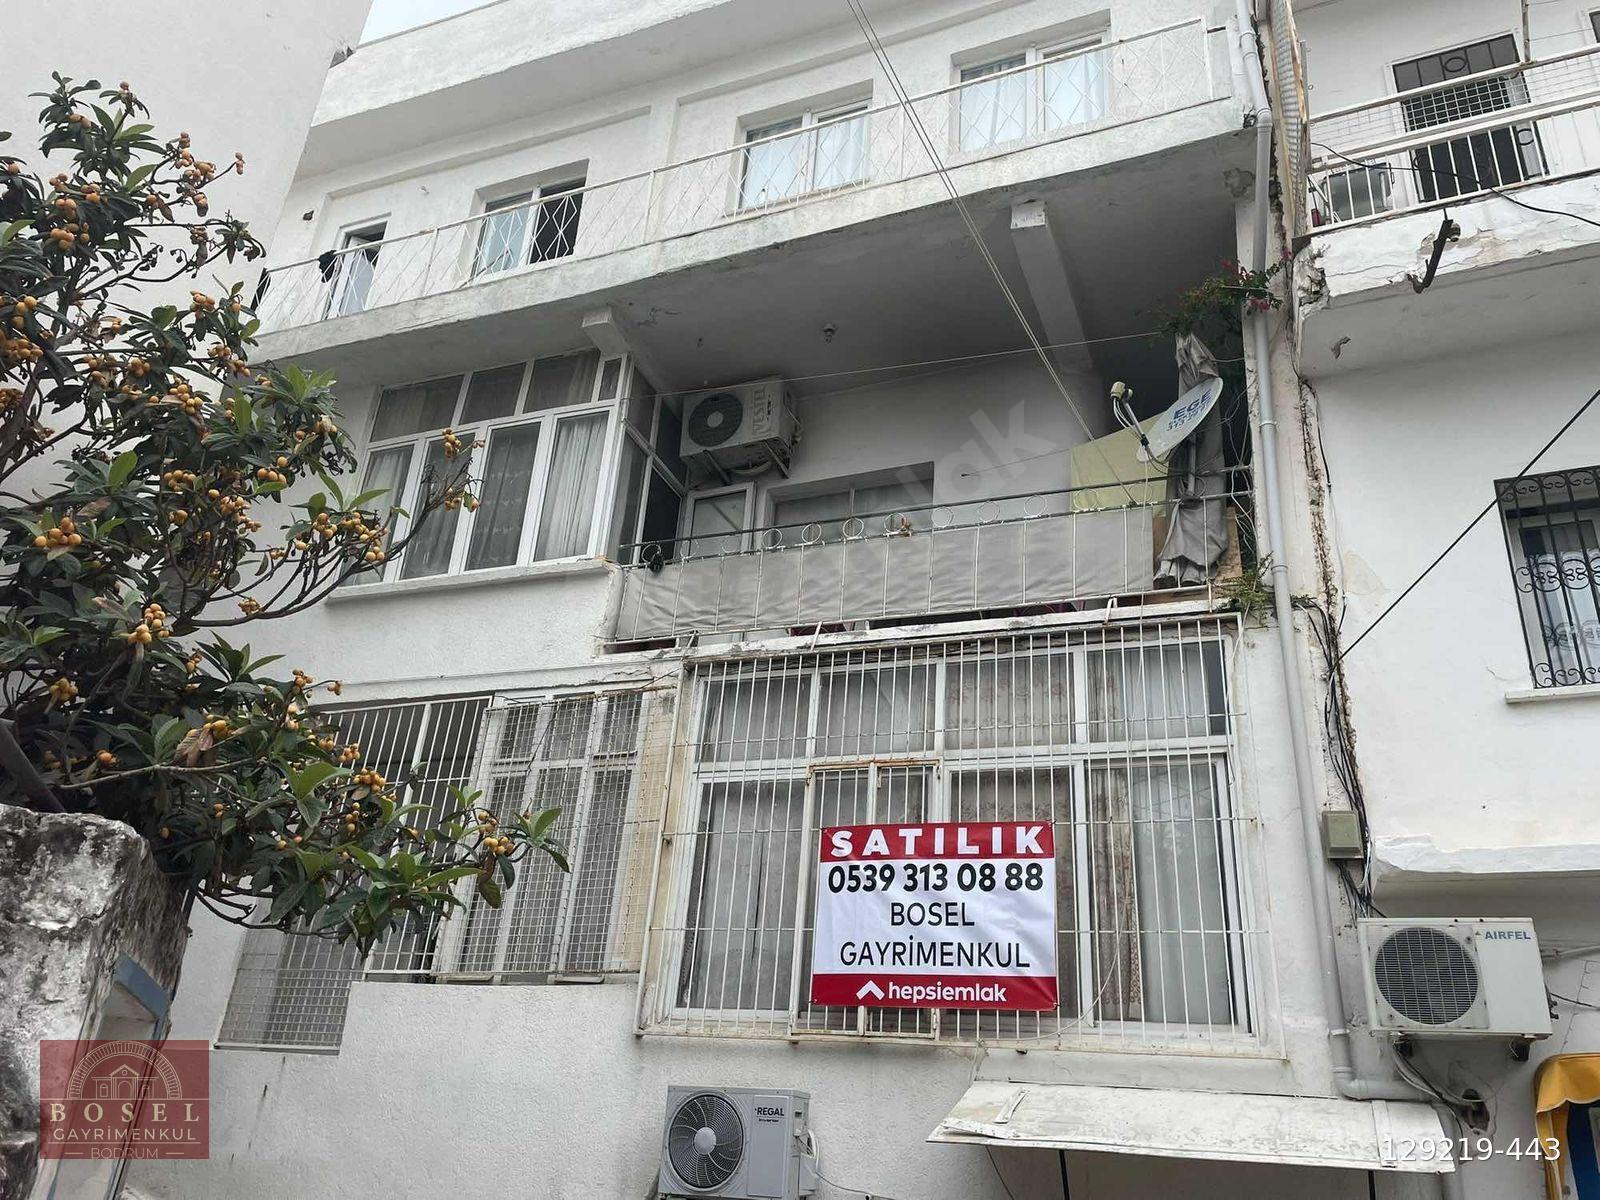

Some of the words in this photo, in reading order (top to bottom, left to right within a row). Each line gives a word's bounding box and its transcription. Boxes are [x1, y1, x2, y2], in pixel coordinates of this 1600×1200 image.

[1173, 389, 1211, 420] EGE
[830, 825, 1044, 857] SATILIK
[828, 863, 895, 893] 0539
[903, 863, 948, 892] 313
[957, 863, 996, 891] 08
[1005, 863, 1043, 891] 88
[890, 902, 975, 927] BOSEL
[1484, 931, 1532, 940] AIRFEL
[840, 935, 1030, 968] GAYRİMENKUL
[888, 982, 1007, 1004] hepsiemlak
[757, 1107, 785, 1116] REGAL
